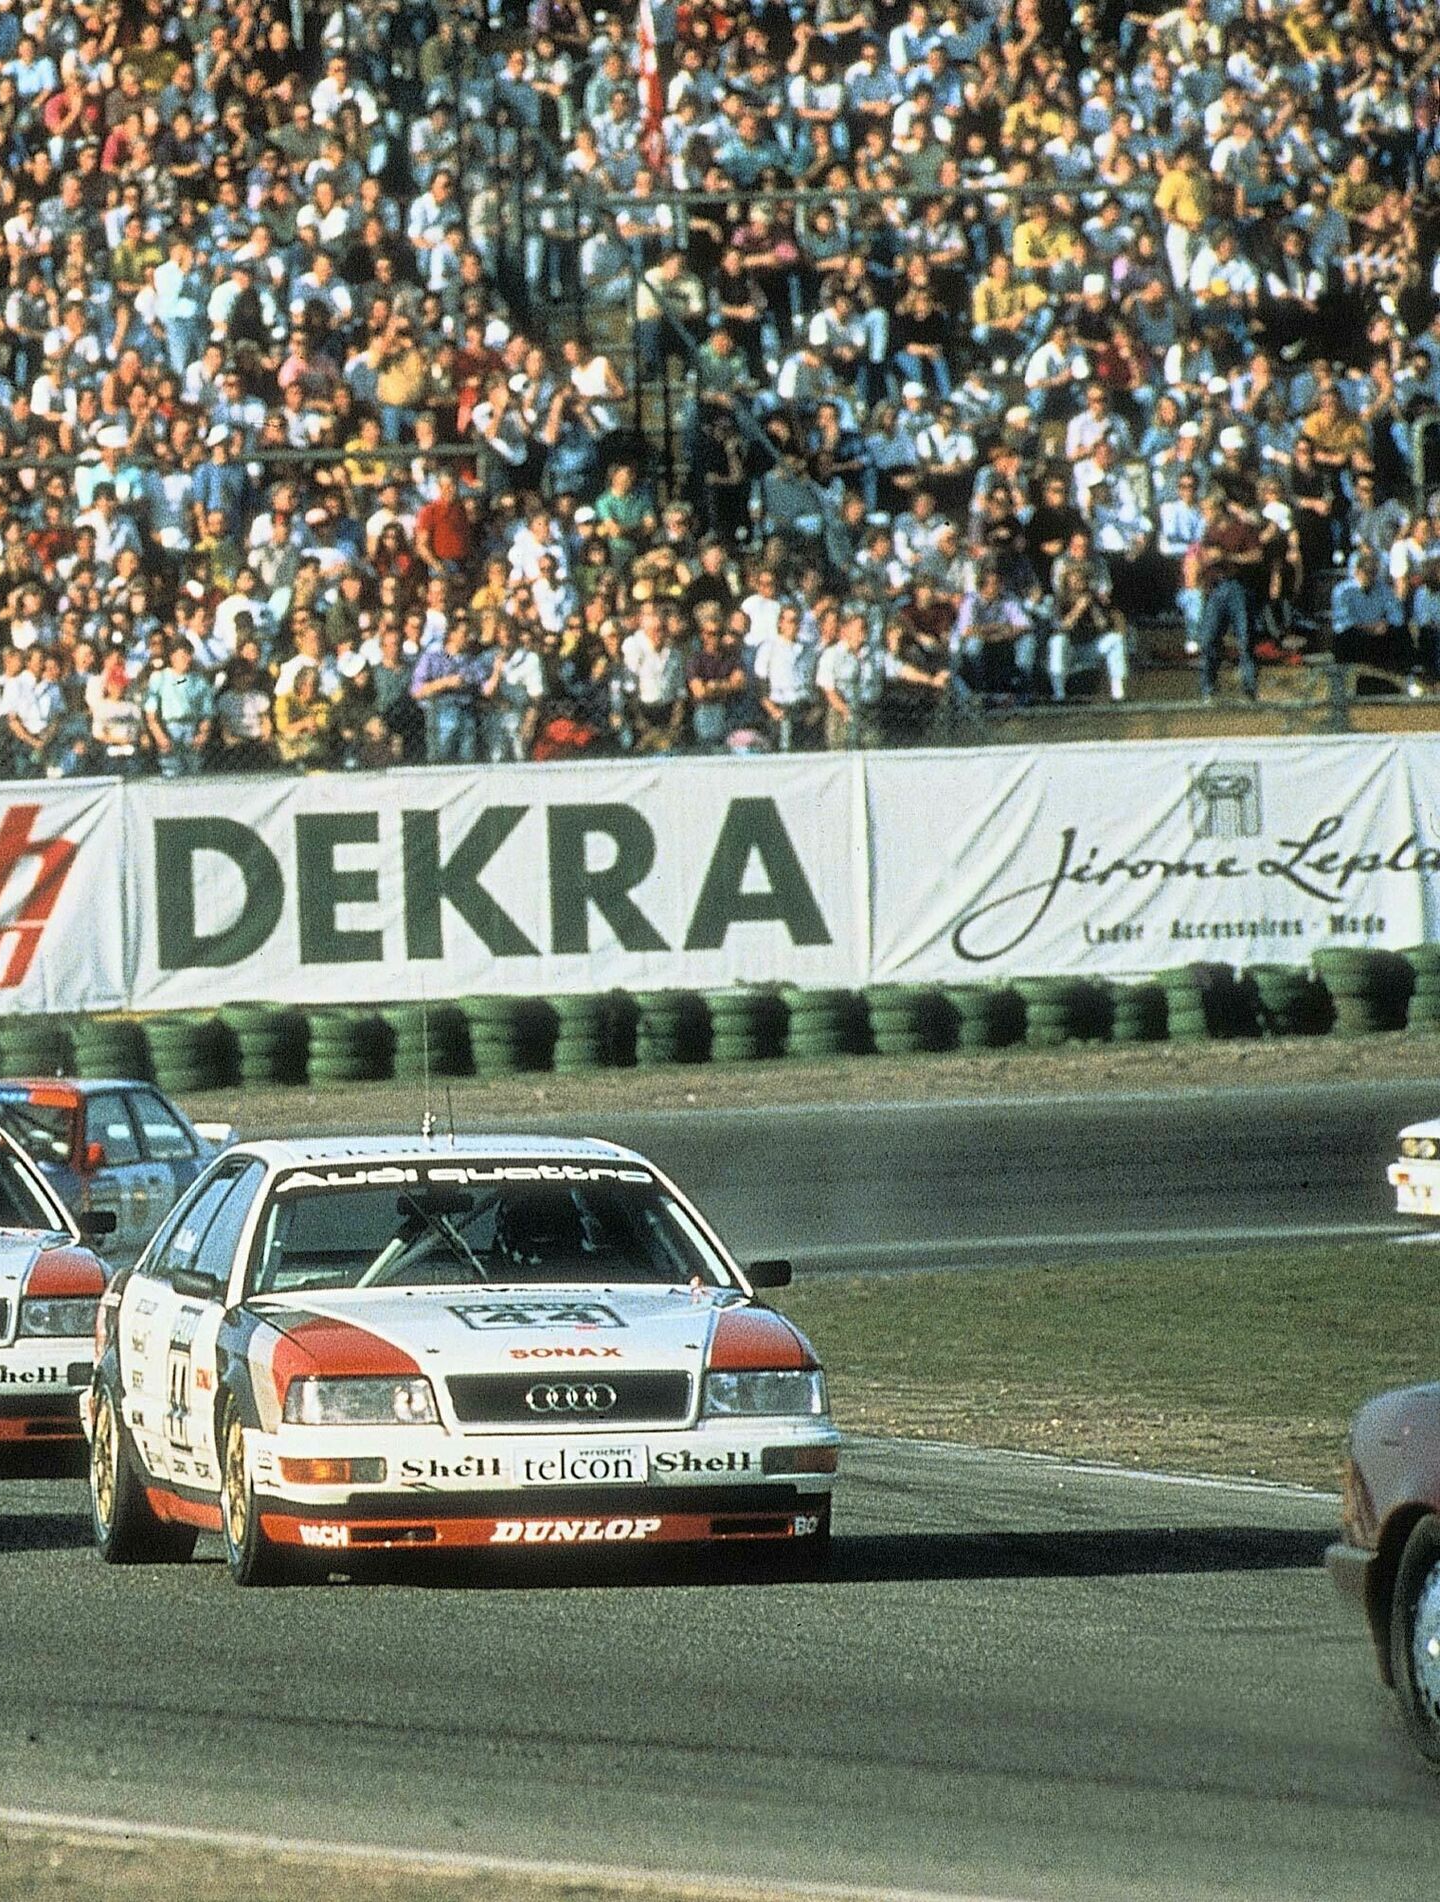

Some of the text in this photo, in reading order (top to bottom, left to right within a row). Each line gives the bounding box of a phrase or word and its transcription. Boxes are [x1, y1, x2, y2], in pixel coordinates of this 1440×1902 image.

[153, 797, 833, 971] DEKRA
[275, 1165, 653, 1192] Audi quattro
[482, 1310, 602, 1326] 44
[509, 1347, 624, 1360] SONAX
[401, 1458, 501, 1478] Shell
[524, 1448, 634, 1482] telcon
[654, 1451, 751, 1473] Shell
[490, 1519, 661, 1543] DUNLOP
